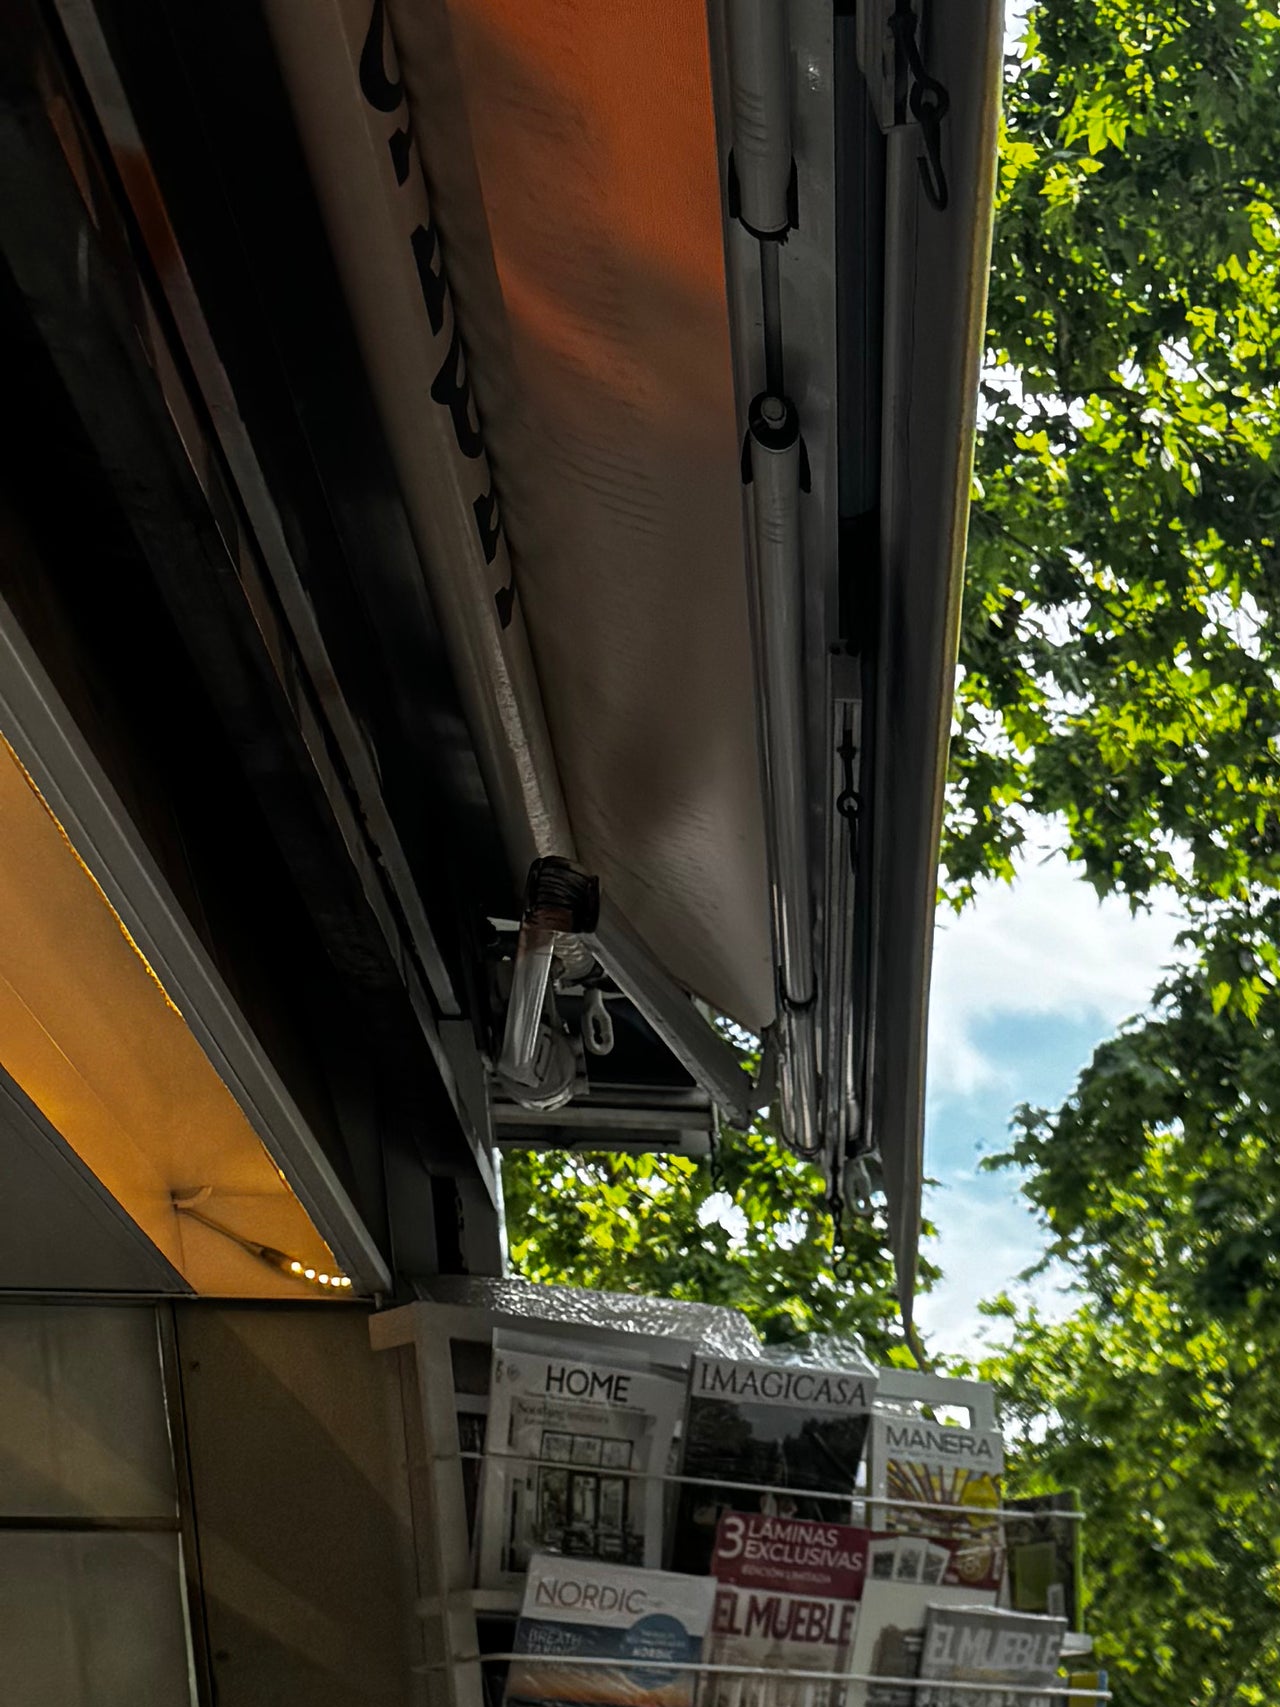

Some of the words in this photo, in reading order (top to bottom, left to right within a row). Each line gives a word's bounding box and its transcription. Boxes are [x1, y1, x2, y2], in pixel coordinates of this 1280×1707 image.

[546, 1364, 632, 1403] HOME
[699, 1363, 867, 1406] IMAGICASA
[886, 1424, 993, 1458] MANERA
[717, 1516, 745, 1559] 3
[747, 1519, 839, 1548] LÁMINAS
[744, 1541, 863, 1571] EXCLUSIVAS
[535, 1580, 647, 1614] NORDIC
[713, 1592, 742, 1638] EL
[746, 1595, 856, 1647] MUEBLE
[528, 1629, 583, 1648] BREATH
[926, 1622, 951, 1665] EL
[957, 1624, 1061, 1668] MUEBLE
